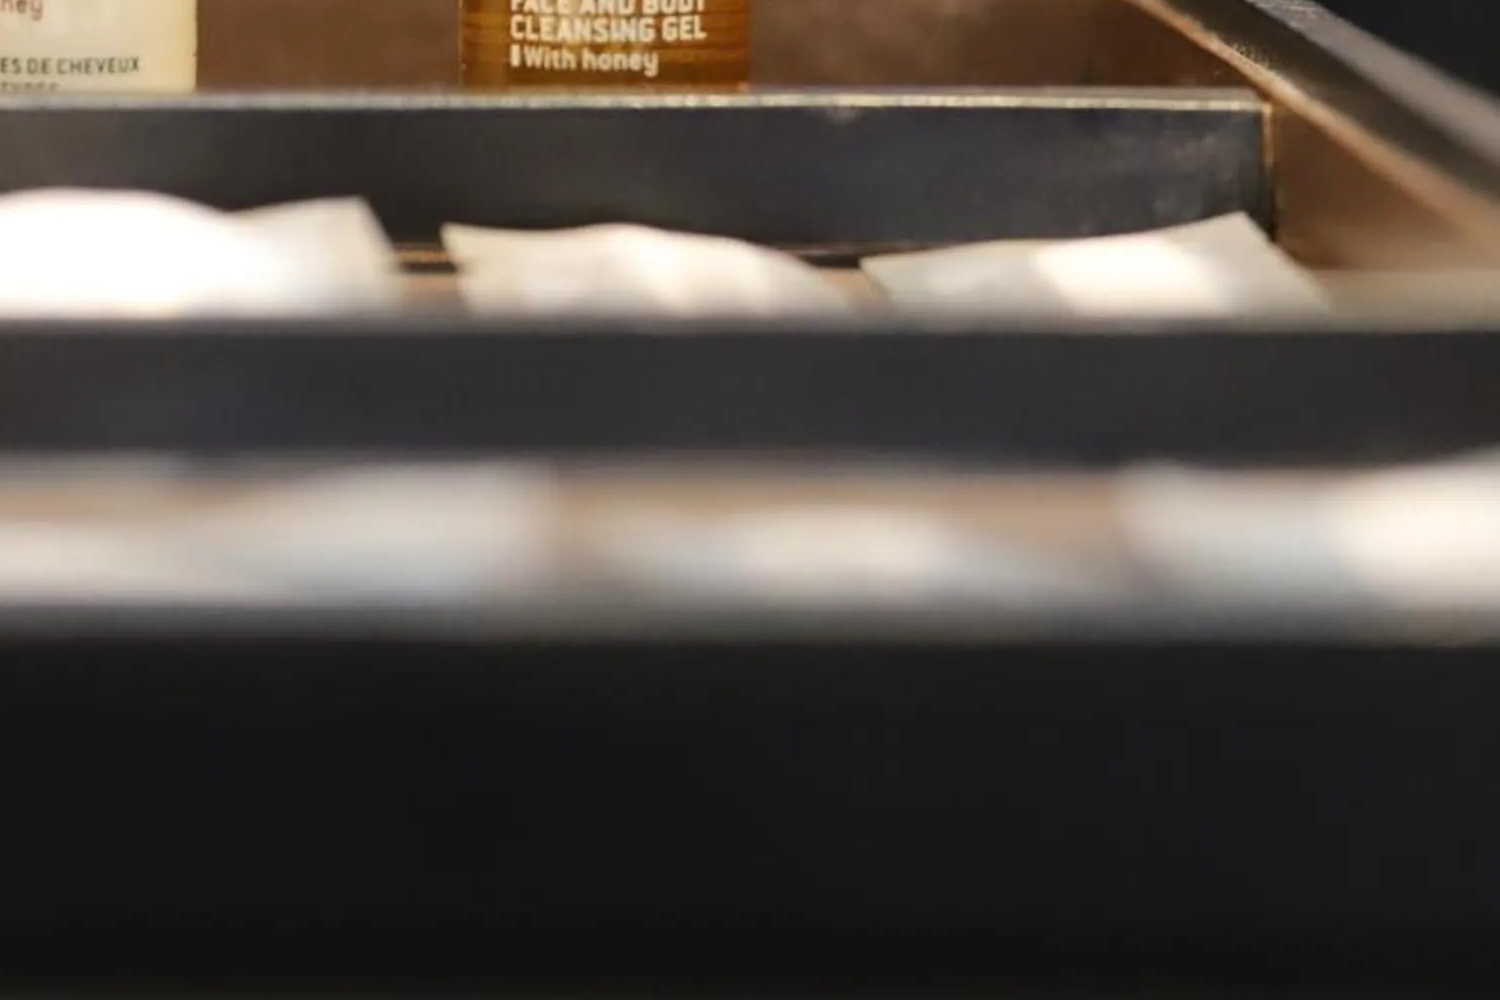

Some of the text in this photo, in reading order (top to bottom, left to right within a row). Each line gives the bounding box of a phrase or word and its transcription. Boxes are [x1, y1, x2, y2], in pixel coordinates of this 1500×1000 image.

[510, 14, 708, 43] CLEANSING GEL
[26, 56, 51, 75] DE
[56, 55, 140, 75] CHEVEUX
[523, 44, 658, 77] With honey
